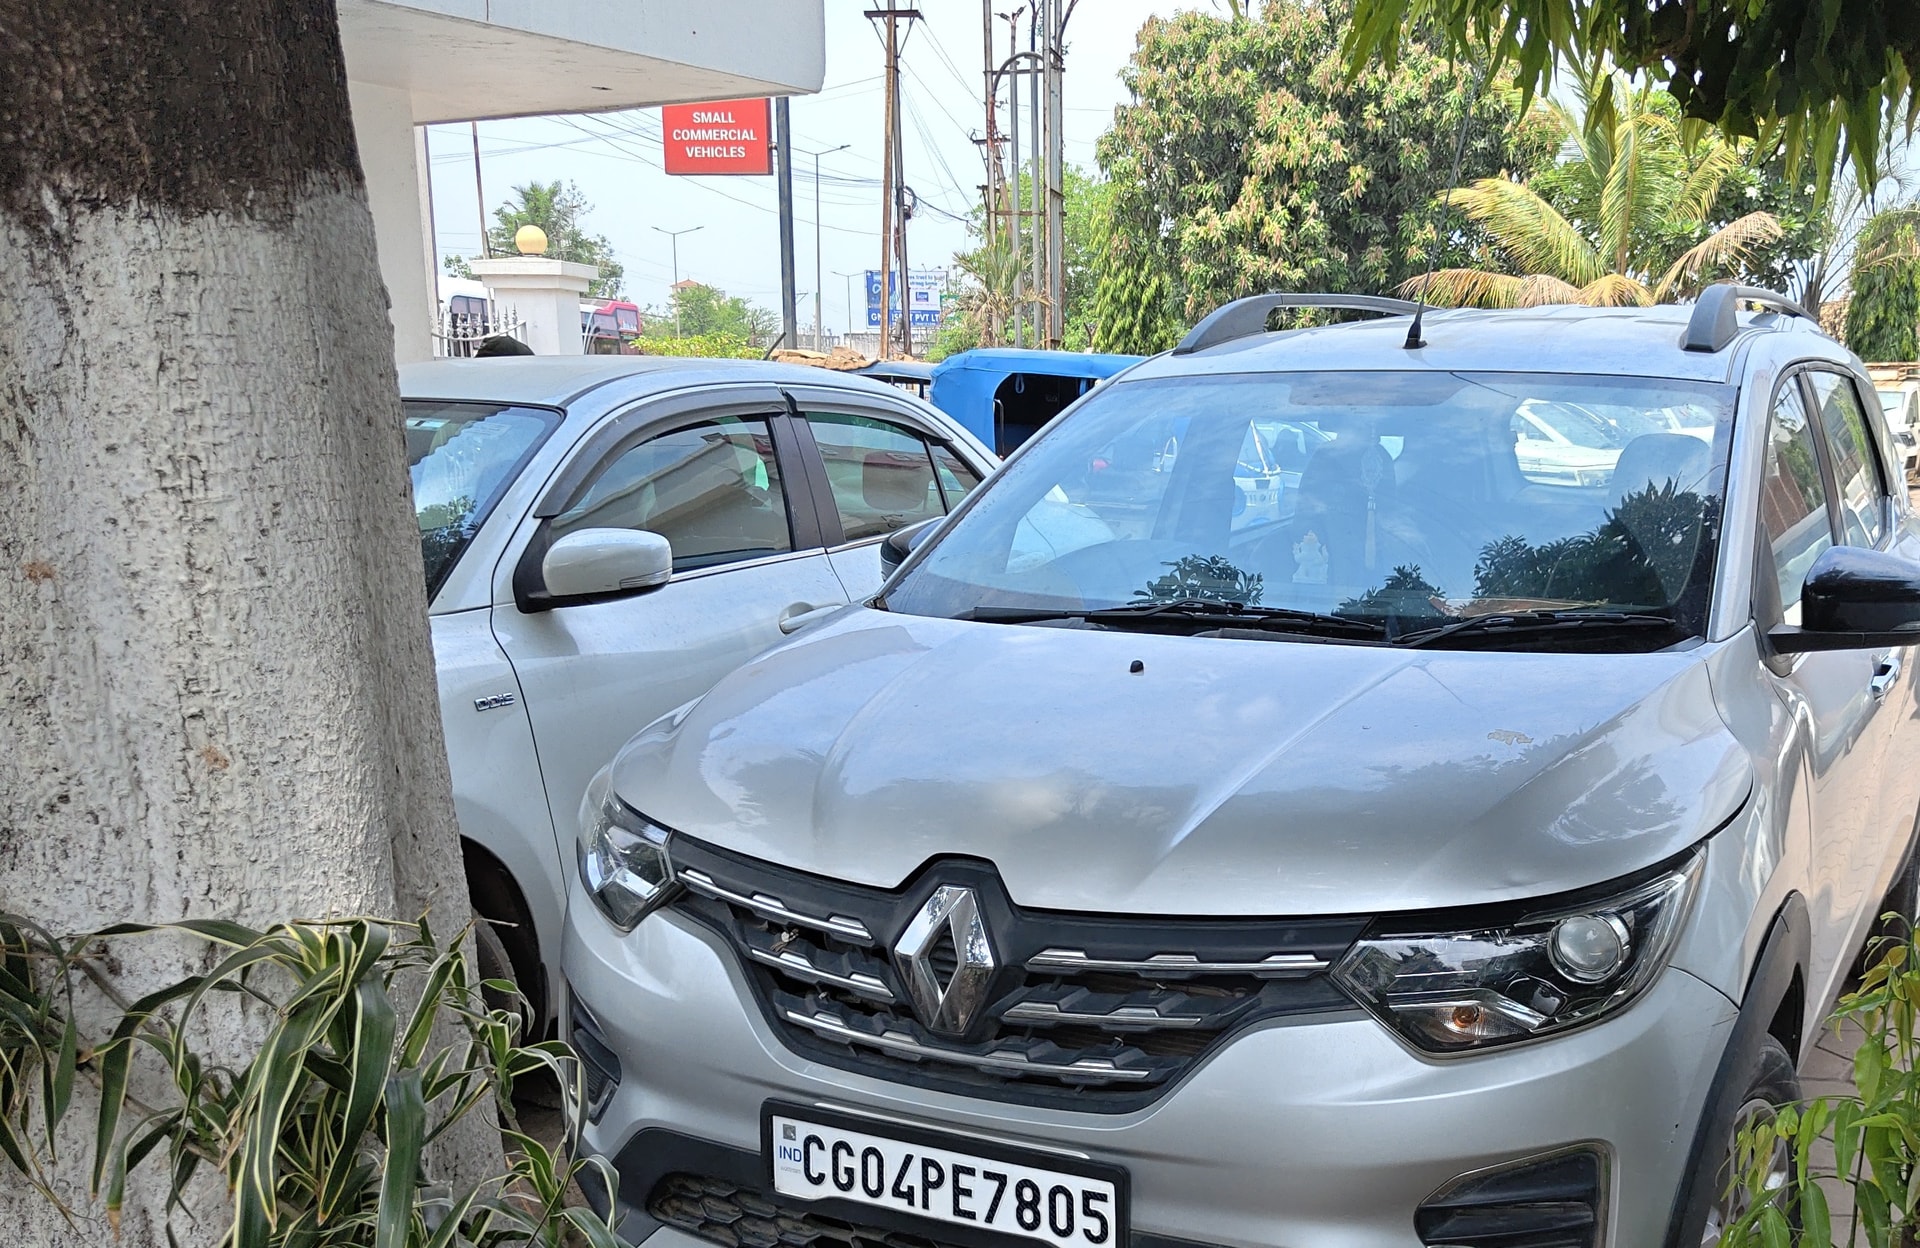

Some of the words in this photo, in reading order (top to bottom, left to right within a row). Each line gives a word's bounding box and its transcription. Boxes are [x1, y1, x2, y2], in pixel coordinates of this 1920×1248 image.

[692, 112, 735, 123] SMALL
[673, 129, 757, 141] COMMERCIAL
[686, 146, 745, 157] VEHICLES
[915, 313, 930, 322] PVT
[779, 1144, 802, 1163] IND
[803, 1133, 1109, 1244] CG04PE7805
